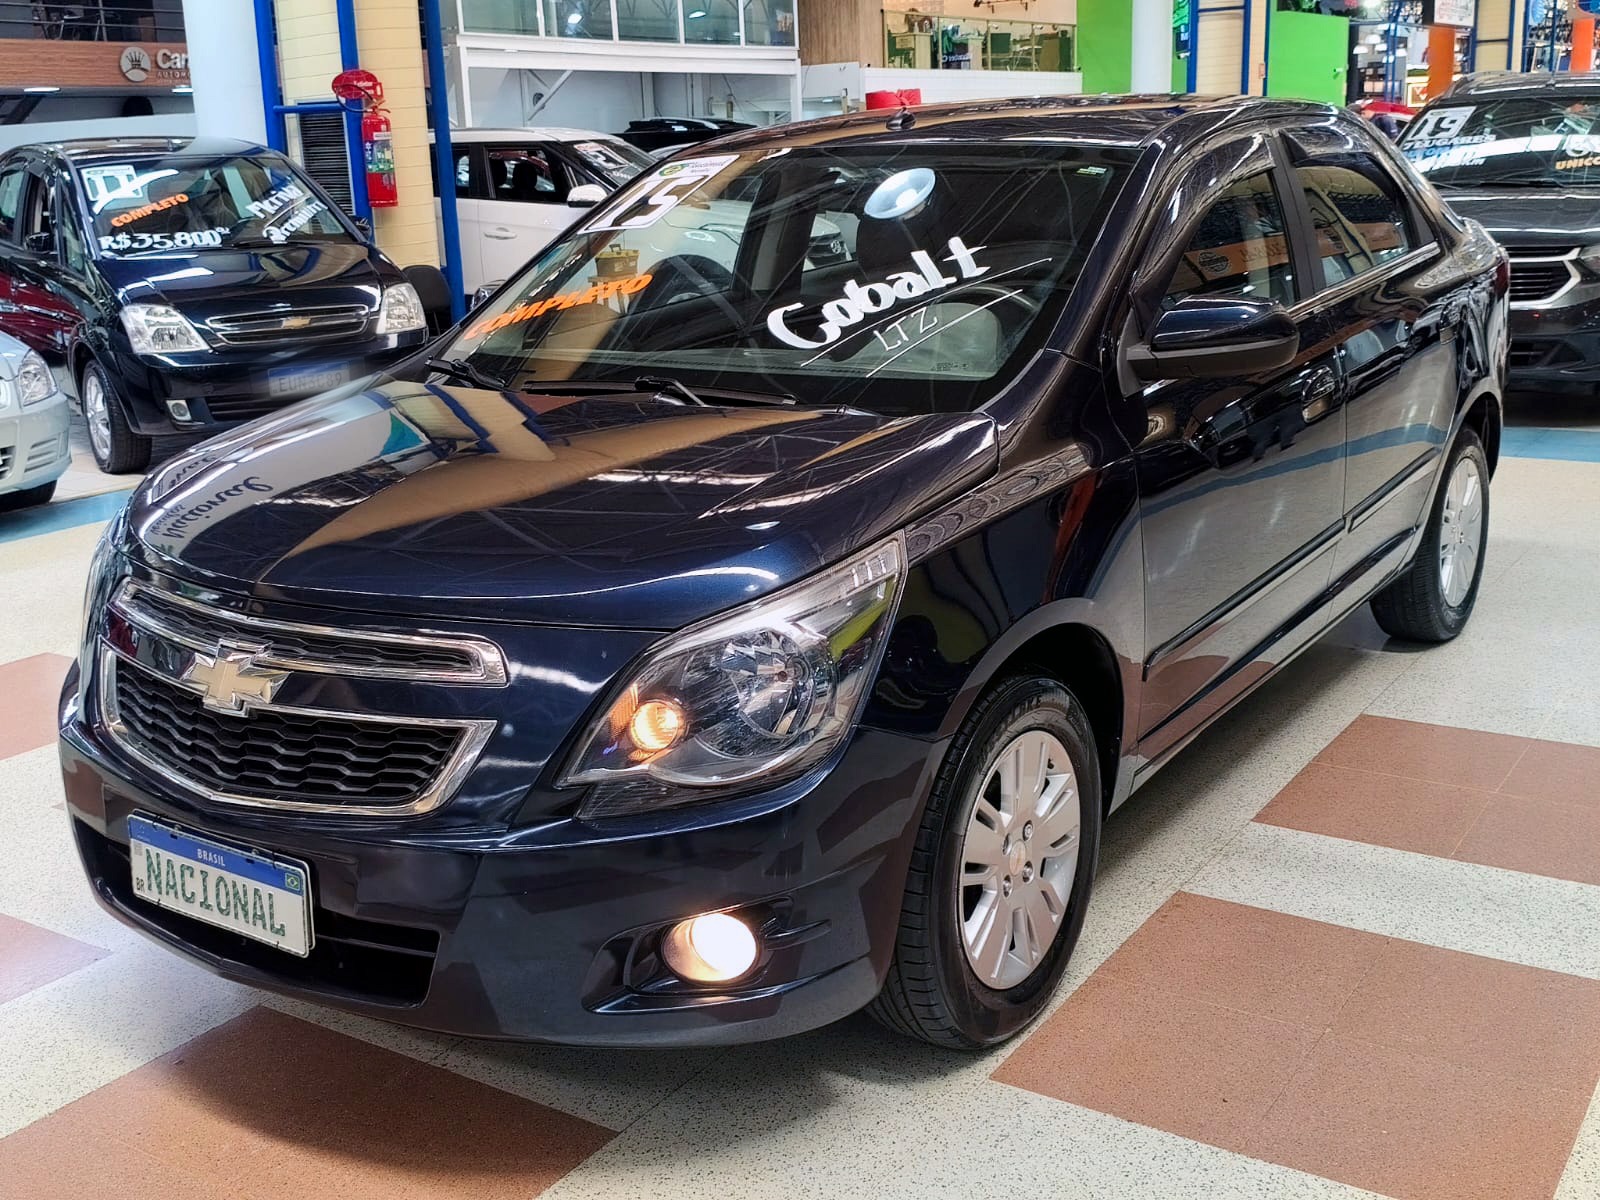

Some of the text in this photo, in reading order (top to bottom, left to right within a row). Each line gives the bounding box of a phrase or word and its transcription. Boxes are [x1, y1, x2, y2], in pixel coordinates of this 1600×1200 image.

[1411, 116, 1466, 139] 19
[111, 193, 189, 227] COMPLETO
[587, 174, 708, 230] 15
[463, 274, 654, 340] COMPLETO
[766, 236, 992, 350] Cobalt
[873, 306, 938, 351] LTZ
[197, 849, 226, 867] BRASIL
[136, 876, 146, 893] BR
[146, 849, 286, 937] NACIONAL
